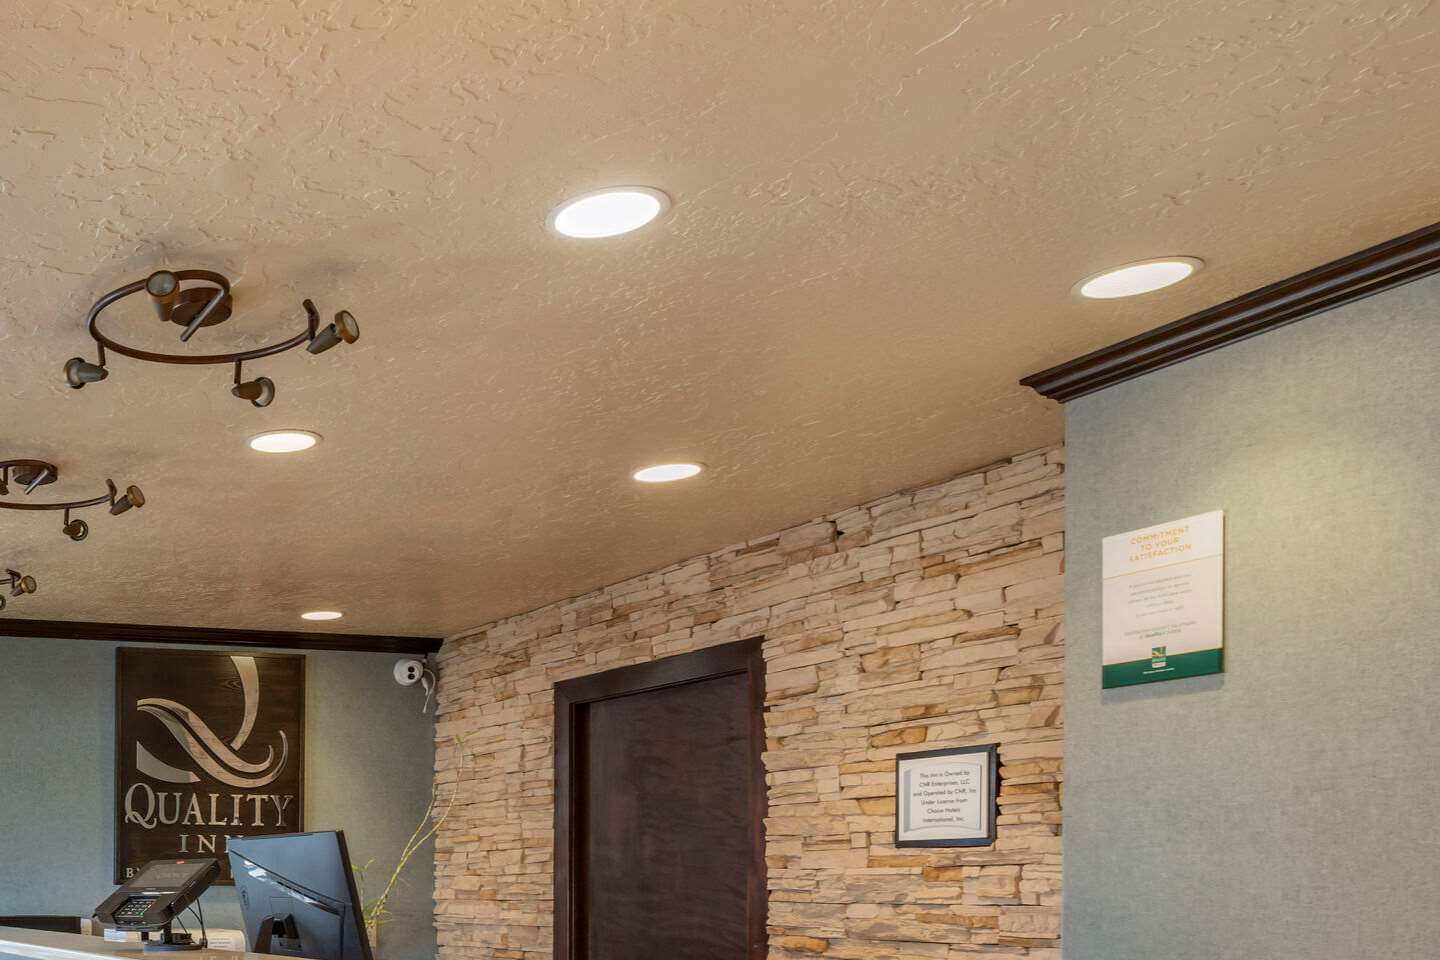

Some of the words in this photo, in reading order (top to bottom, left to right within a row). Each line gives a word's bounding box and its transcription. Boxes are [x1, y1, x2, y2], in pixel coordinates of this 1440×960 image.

[1130, 525, 1190, 545] COMMITMENT
[1140, 542, 1153, 552] TO
[1154, 536, 1181, 549] YOUR
[1129, 543, 1193, 563] SATISFACTION
[124, 782, 294, 830] QUALITY
